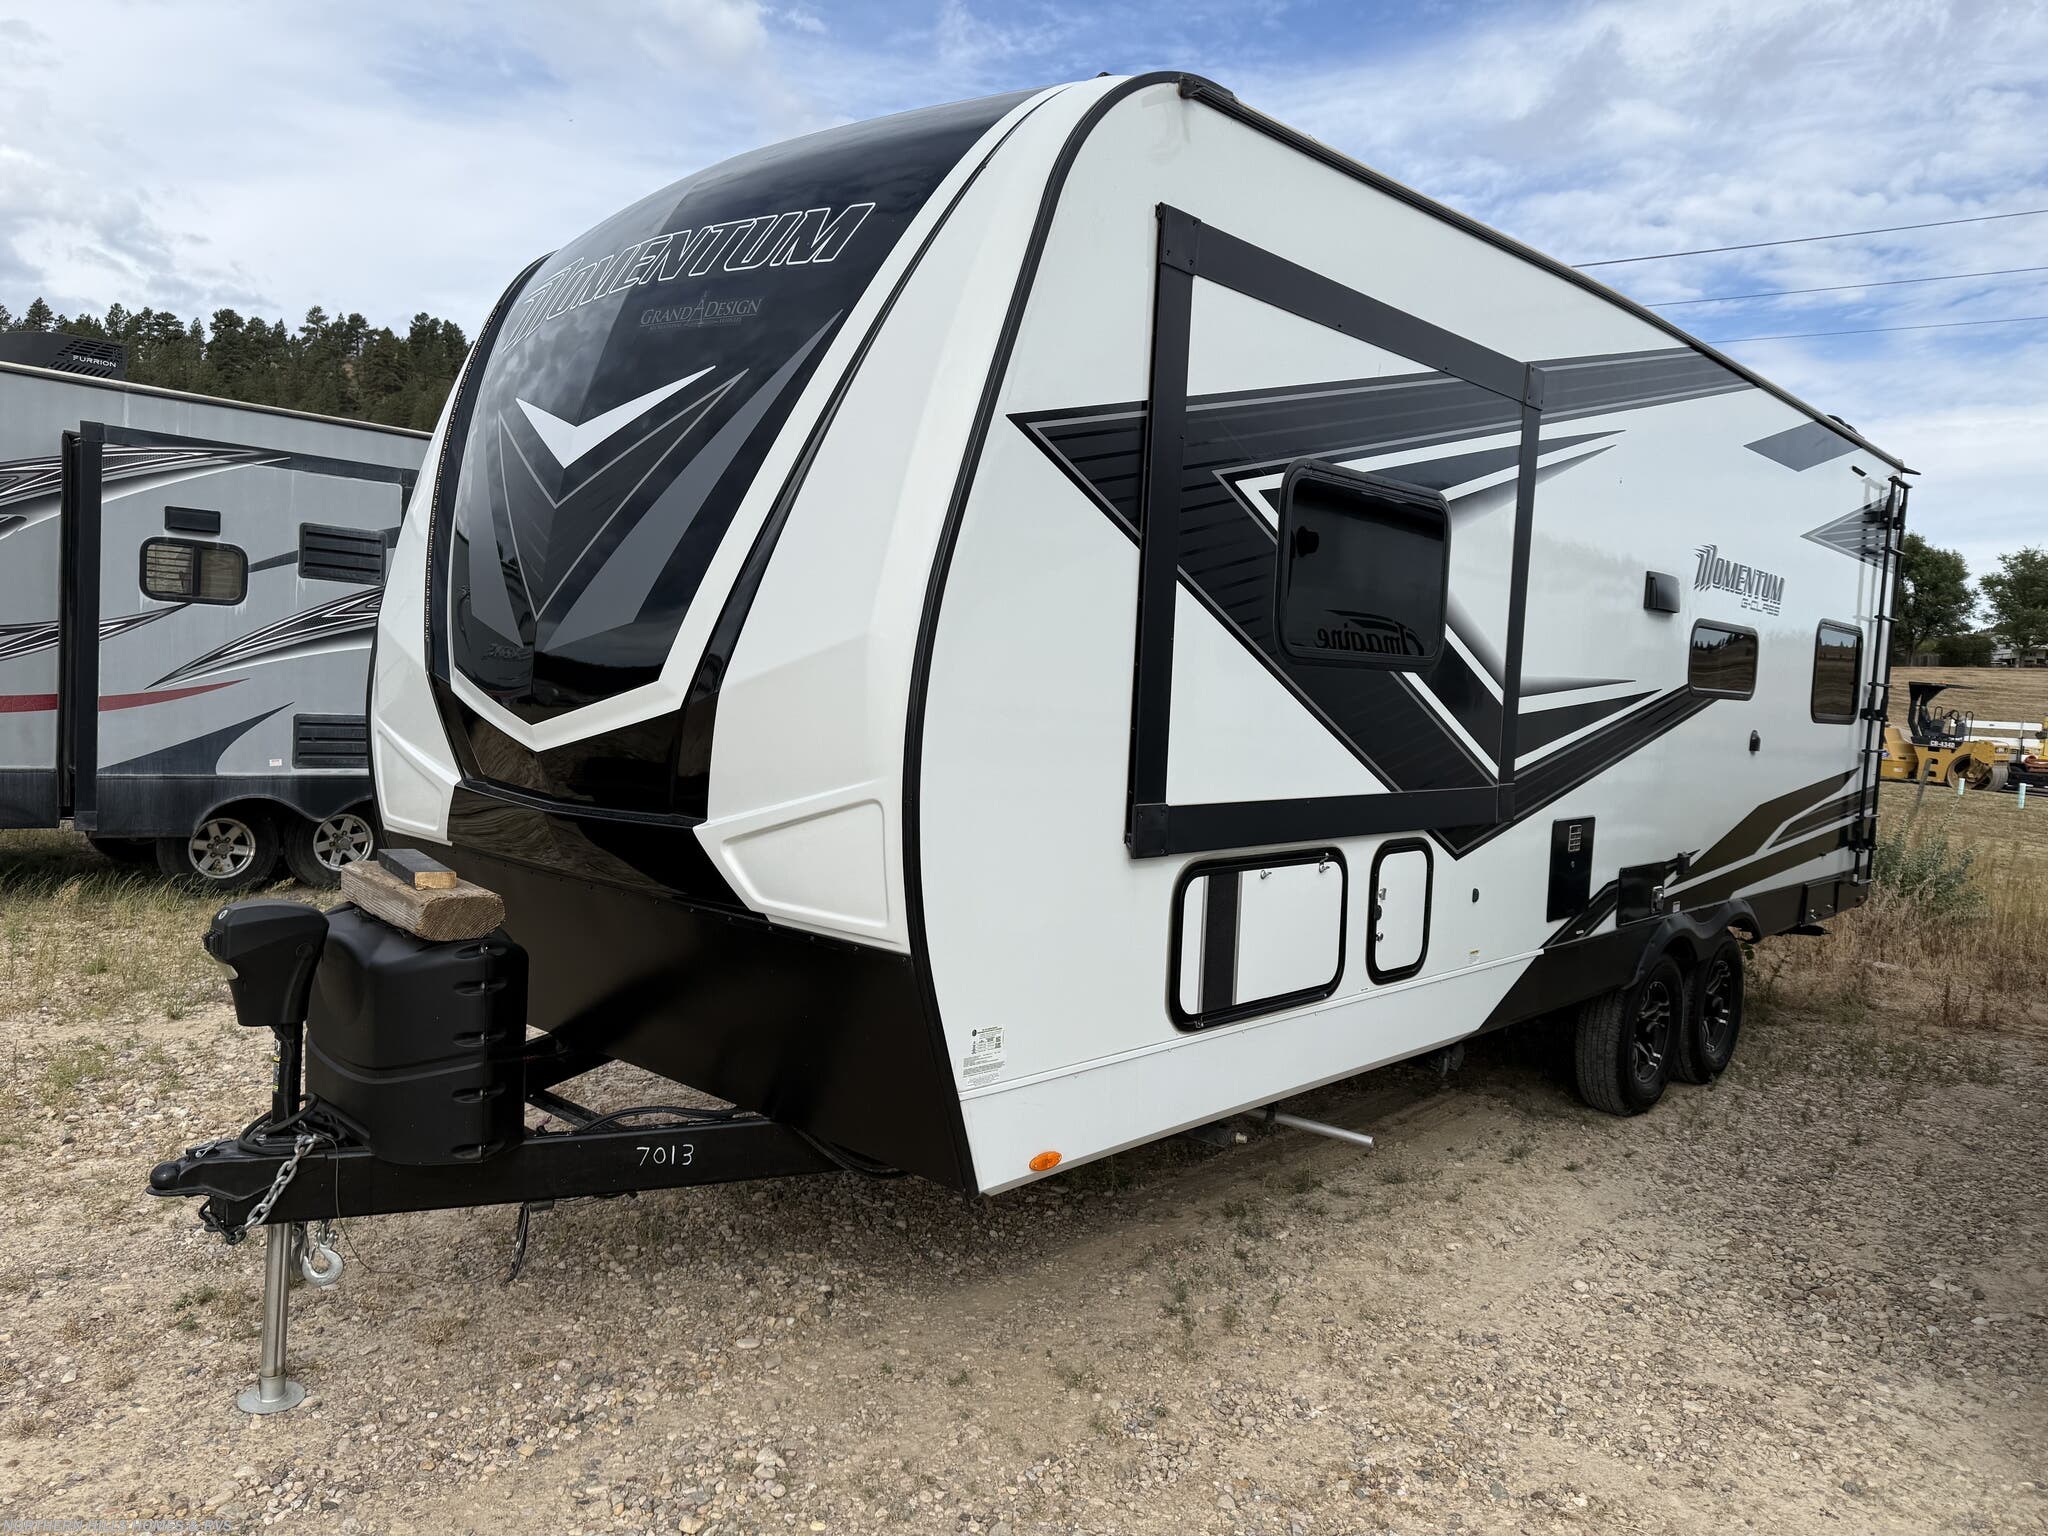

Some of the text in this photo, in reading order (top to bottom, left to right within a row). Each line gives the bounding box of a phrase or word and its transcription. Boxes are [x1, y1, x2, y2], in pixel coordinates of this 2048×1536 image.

[502, 202, 876, 352] MOMENTUM
[639, 298, 763, 325] GRAND DESIGN
[72, 354, 117, 368] FURRION
[1693, 543, 1785, 606] MOMENTUM
[636, 1143, 694, 1167] 7013
